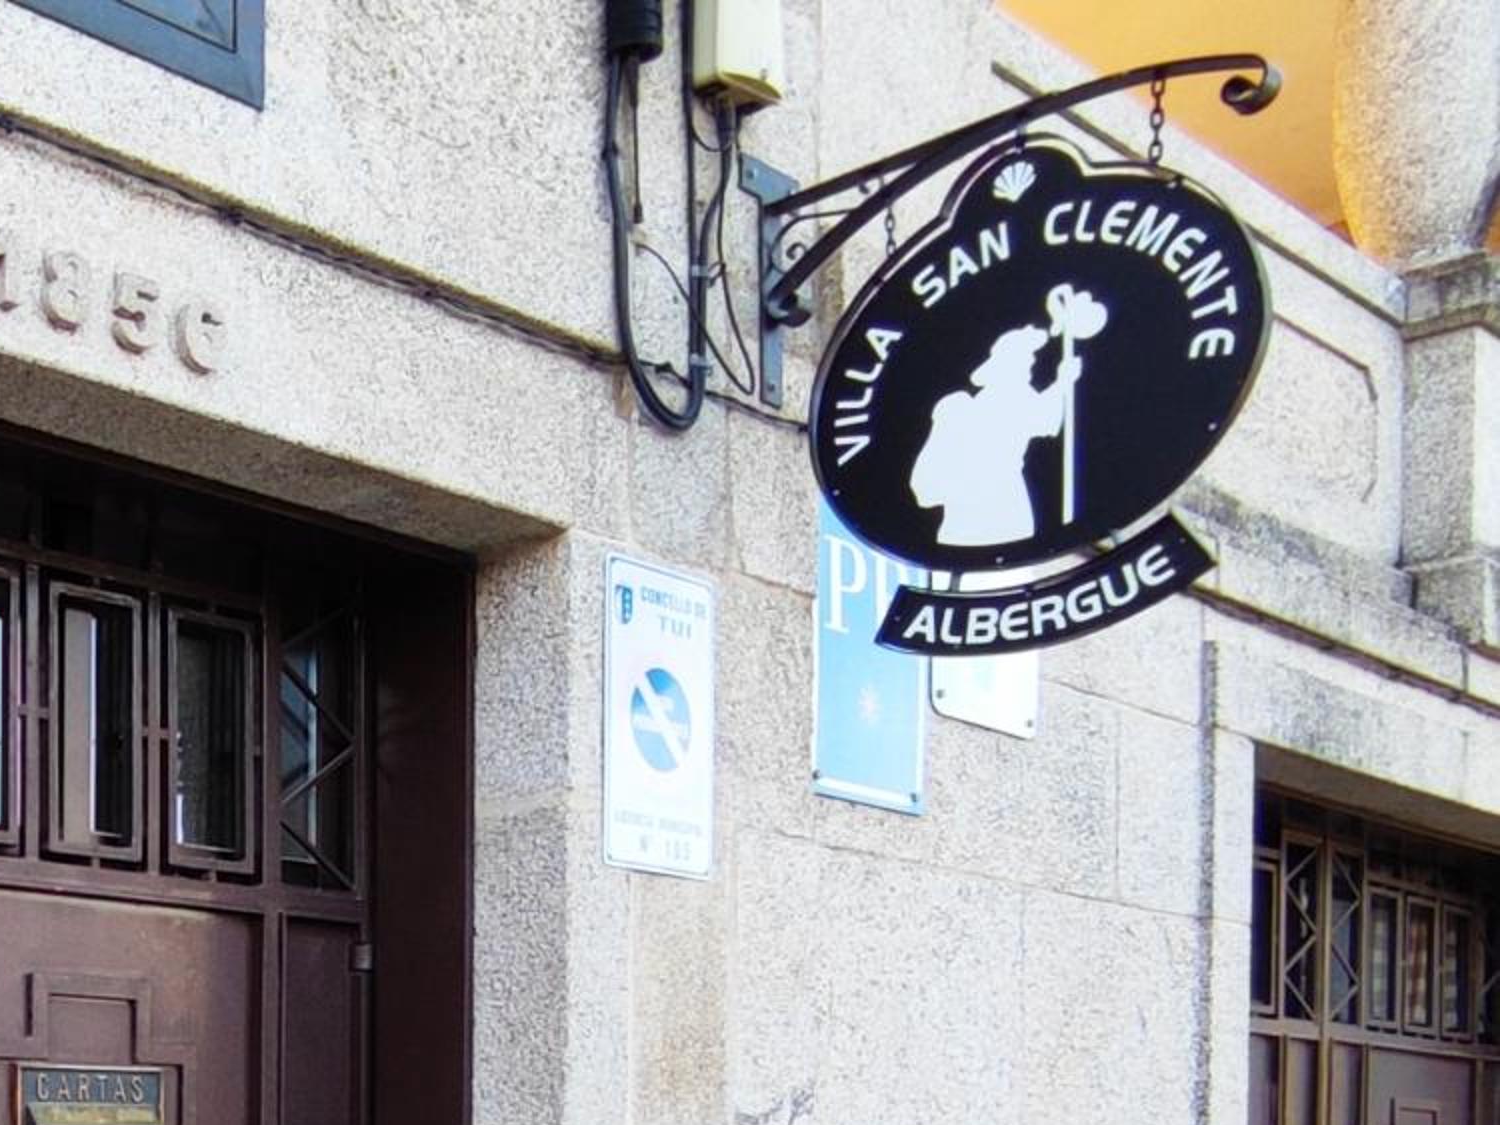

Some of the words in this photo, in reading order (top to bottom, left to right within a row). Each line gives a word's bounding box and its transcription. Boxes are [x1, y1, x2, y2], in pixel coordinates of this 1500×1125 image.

[833, 325, 903, 467] VILLA
[910, 222, 1010, 308] SAN
[1043, 200, 1240, 360] CLEMENTE
[902, 544, 1177, 646] ALBERGUE
[36, 1072, 145, 1102] CARTAS
